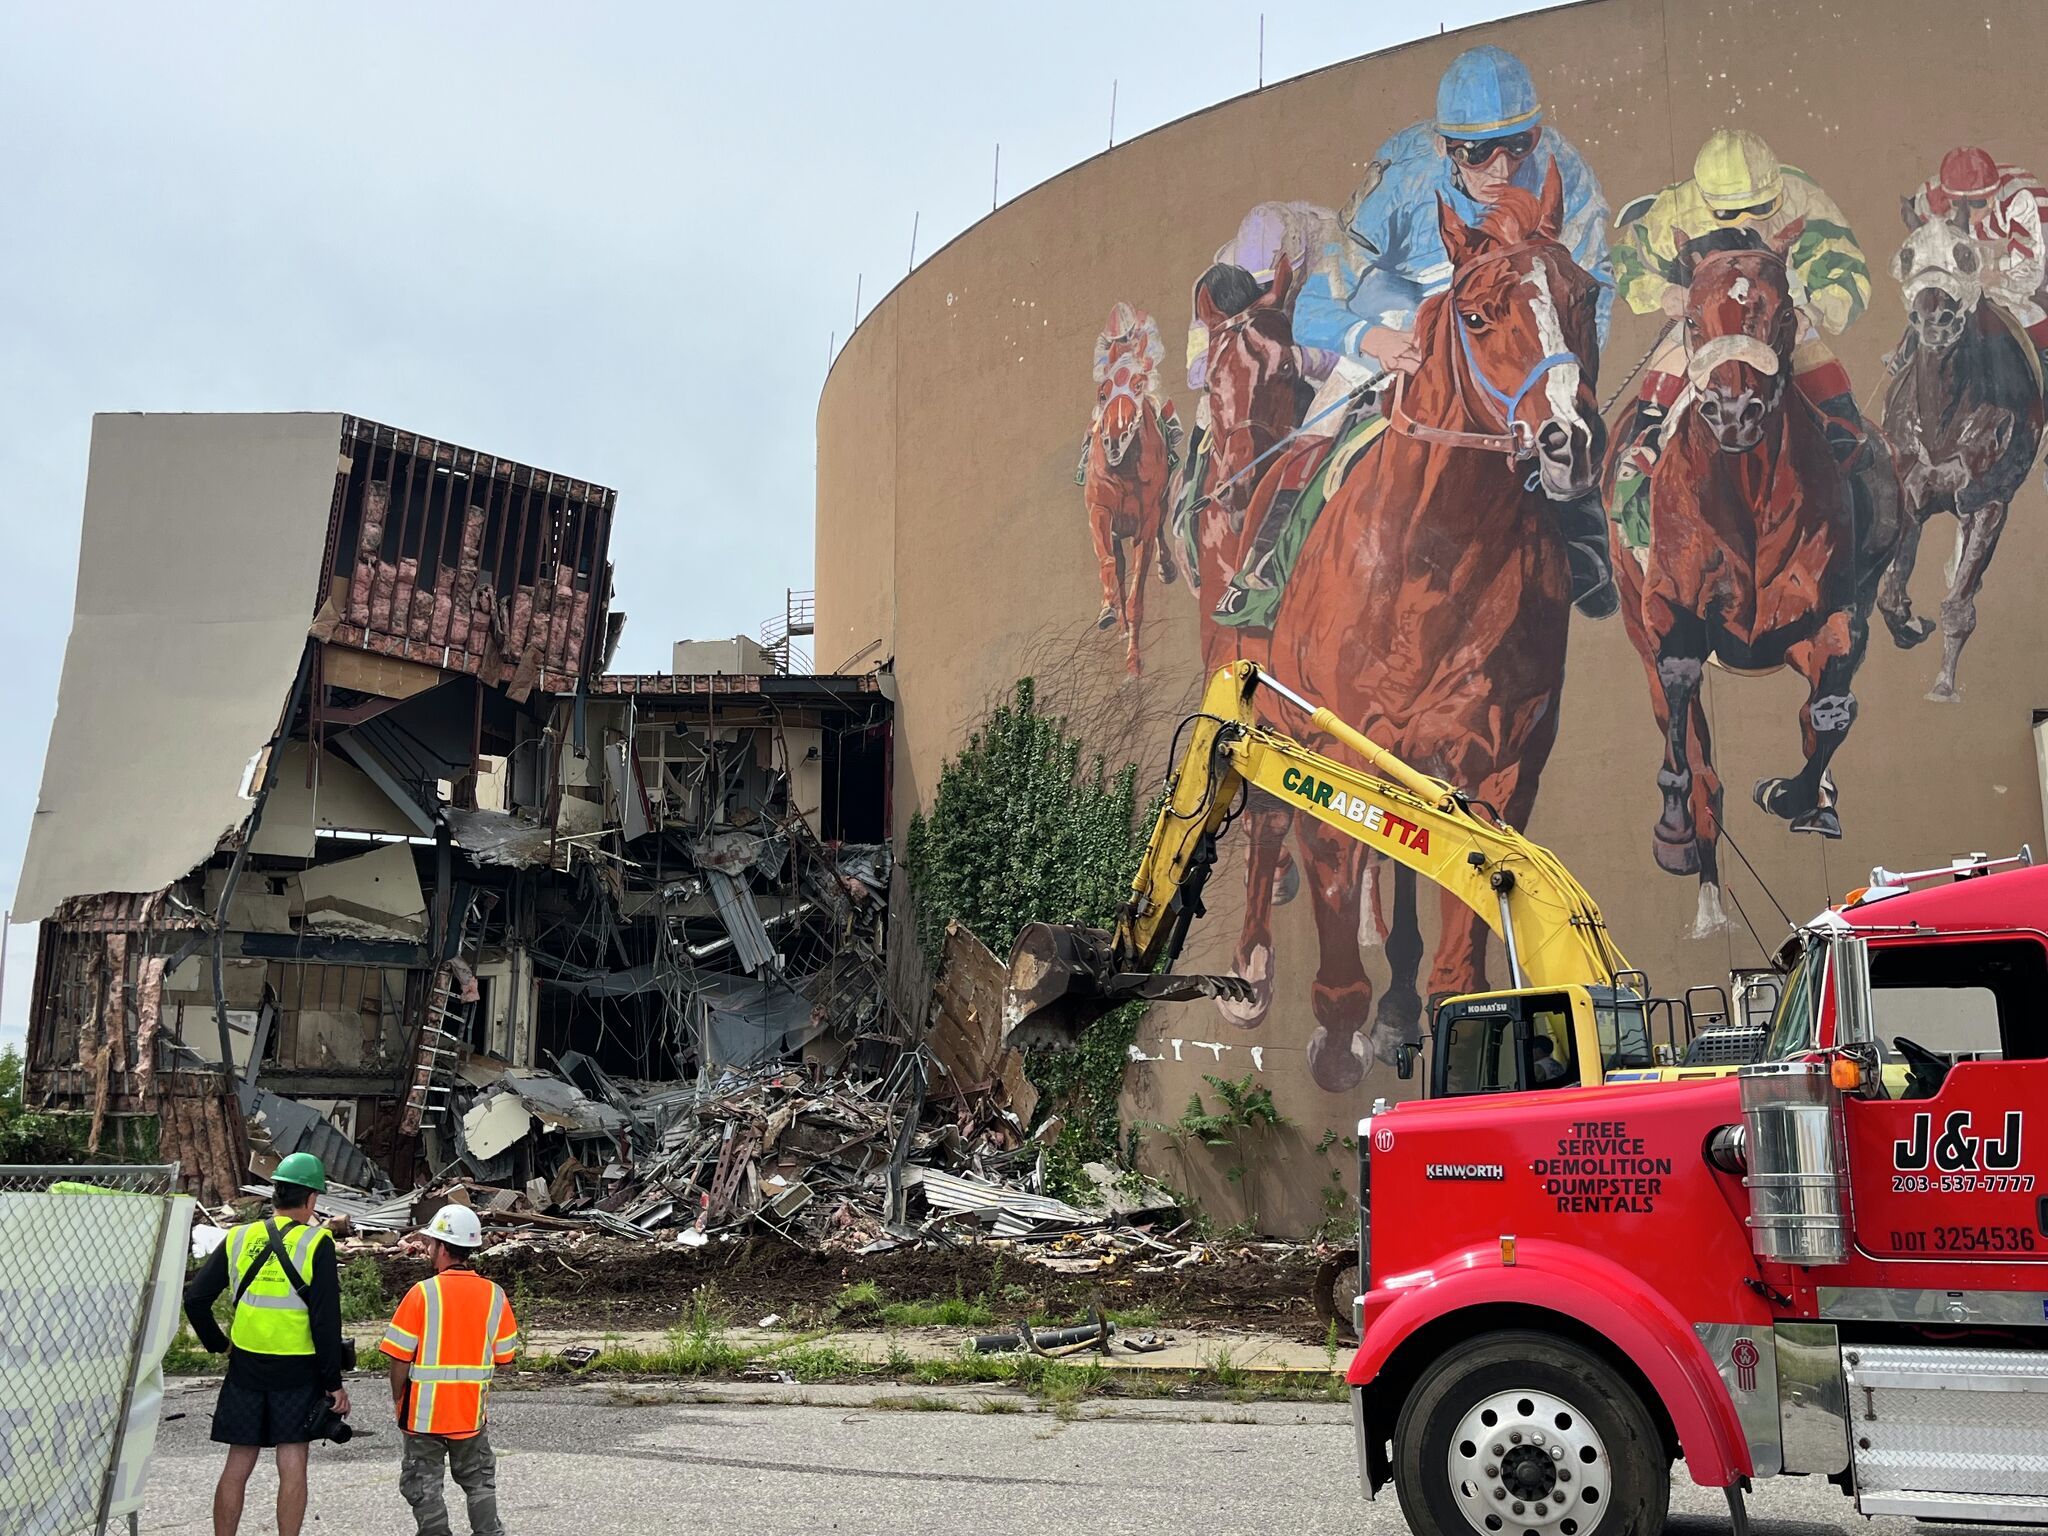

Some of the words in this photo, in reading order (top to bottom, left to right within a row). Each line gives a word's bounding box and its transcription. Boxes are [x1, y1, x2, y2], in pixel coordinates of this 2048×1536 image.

[1282, 767, 1430, 856] CARABETTA
[1467, 1002, 1507, 1014] KOMATSU
[1572, 1122, 1626, 1138] TREE
[1377, 1131, 1391, 1149] 117
[1557, 1139, 1645, 1156] SERVICE
[1894, 1111, 2022, 1172] J&J
[1426, 1164, 1503, 1178] KENWORTH
[1534, 1158, 1671, 1175] DEMOLITION
[1547, 1178, 1661, 1195] DUMPSTER
[1892, 1175, 2034, 1192] 203-537-7777
[1557, 1196, 1653, 1213] RENTALS
[1891, 1231, 1926, 1251] DOT
[1934, 1227, 2034, 1251] 3254536
